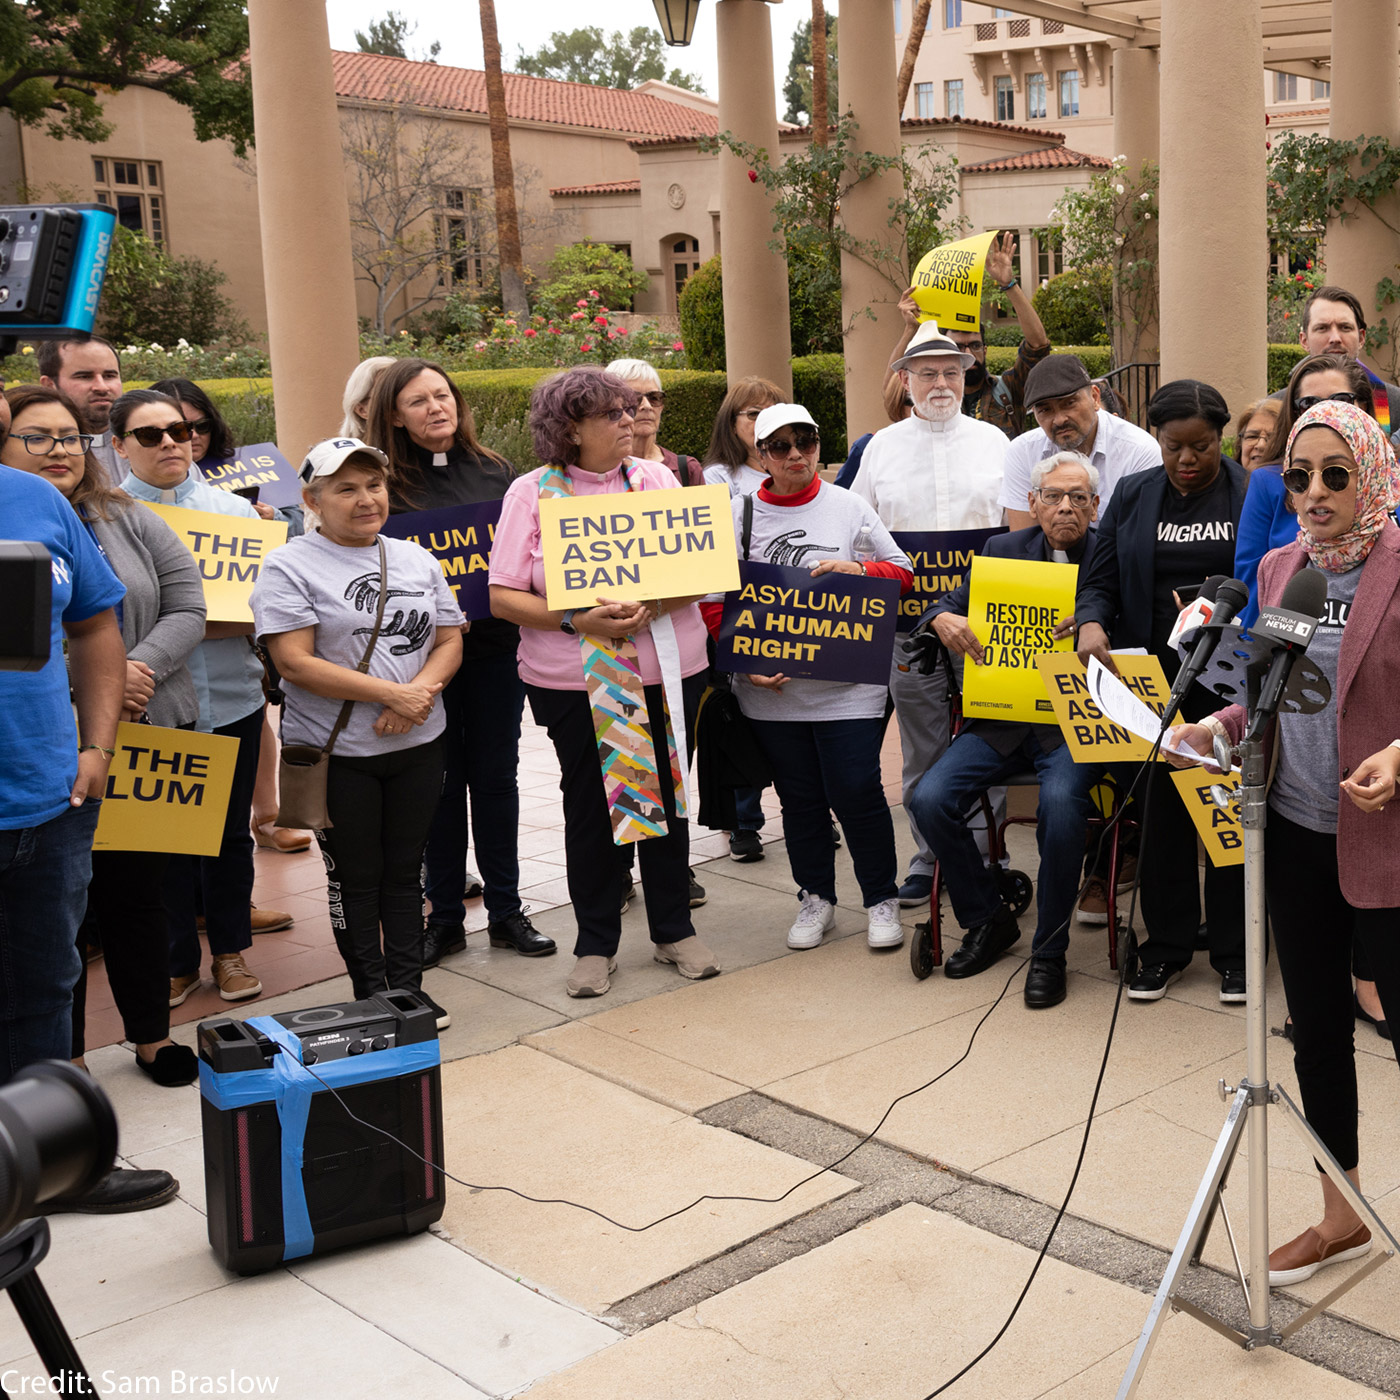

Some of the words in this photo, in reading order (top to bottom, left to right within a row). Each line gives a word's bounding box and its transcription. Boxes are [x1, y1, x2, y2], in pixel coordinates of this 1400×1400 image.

[929, 260, 970, 280] ACCESS
[932, 250, 977, 266] RESTORE
[84, 232, 110, 316] DRACAST
[918, 272, 931, 286] TO
[932, 275, 978, 297] ASYLUM
[250, 455, 276, 468] IS
[559, 514, 635, 538] END
[642, 506, 712, 531] THE
[187, 531, 263, 558] THE
[561, 530, 715, 565] ASYLUM
[564, 564, 641, 590] BAN
[738, 583, 852, 614] ASYLUM
[861, 598, 886, 617] IS
[735, 609, 756, 630] A
[765, 612, 874, 642] HUMAN
[986, 602, 1060, 628] RESTORE
[1262, 612, 1296, 626] SPECTRUM
[1265, 620, 1294, 632] NEWS
[732, 636, 821, 662] RIGHT
[989, 624, 1054, 649] ACCESS
[982, 645, 994, 666] O
[1074, 724, 1132, 746] BAN
[122, 746, 210, 778] THE
[104, 775, 205, 806] LUM
[310, 1038, 344, 1048] PATHFINDER
[318, 1033, 340, 1041] ION
